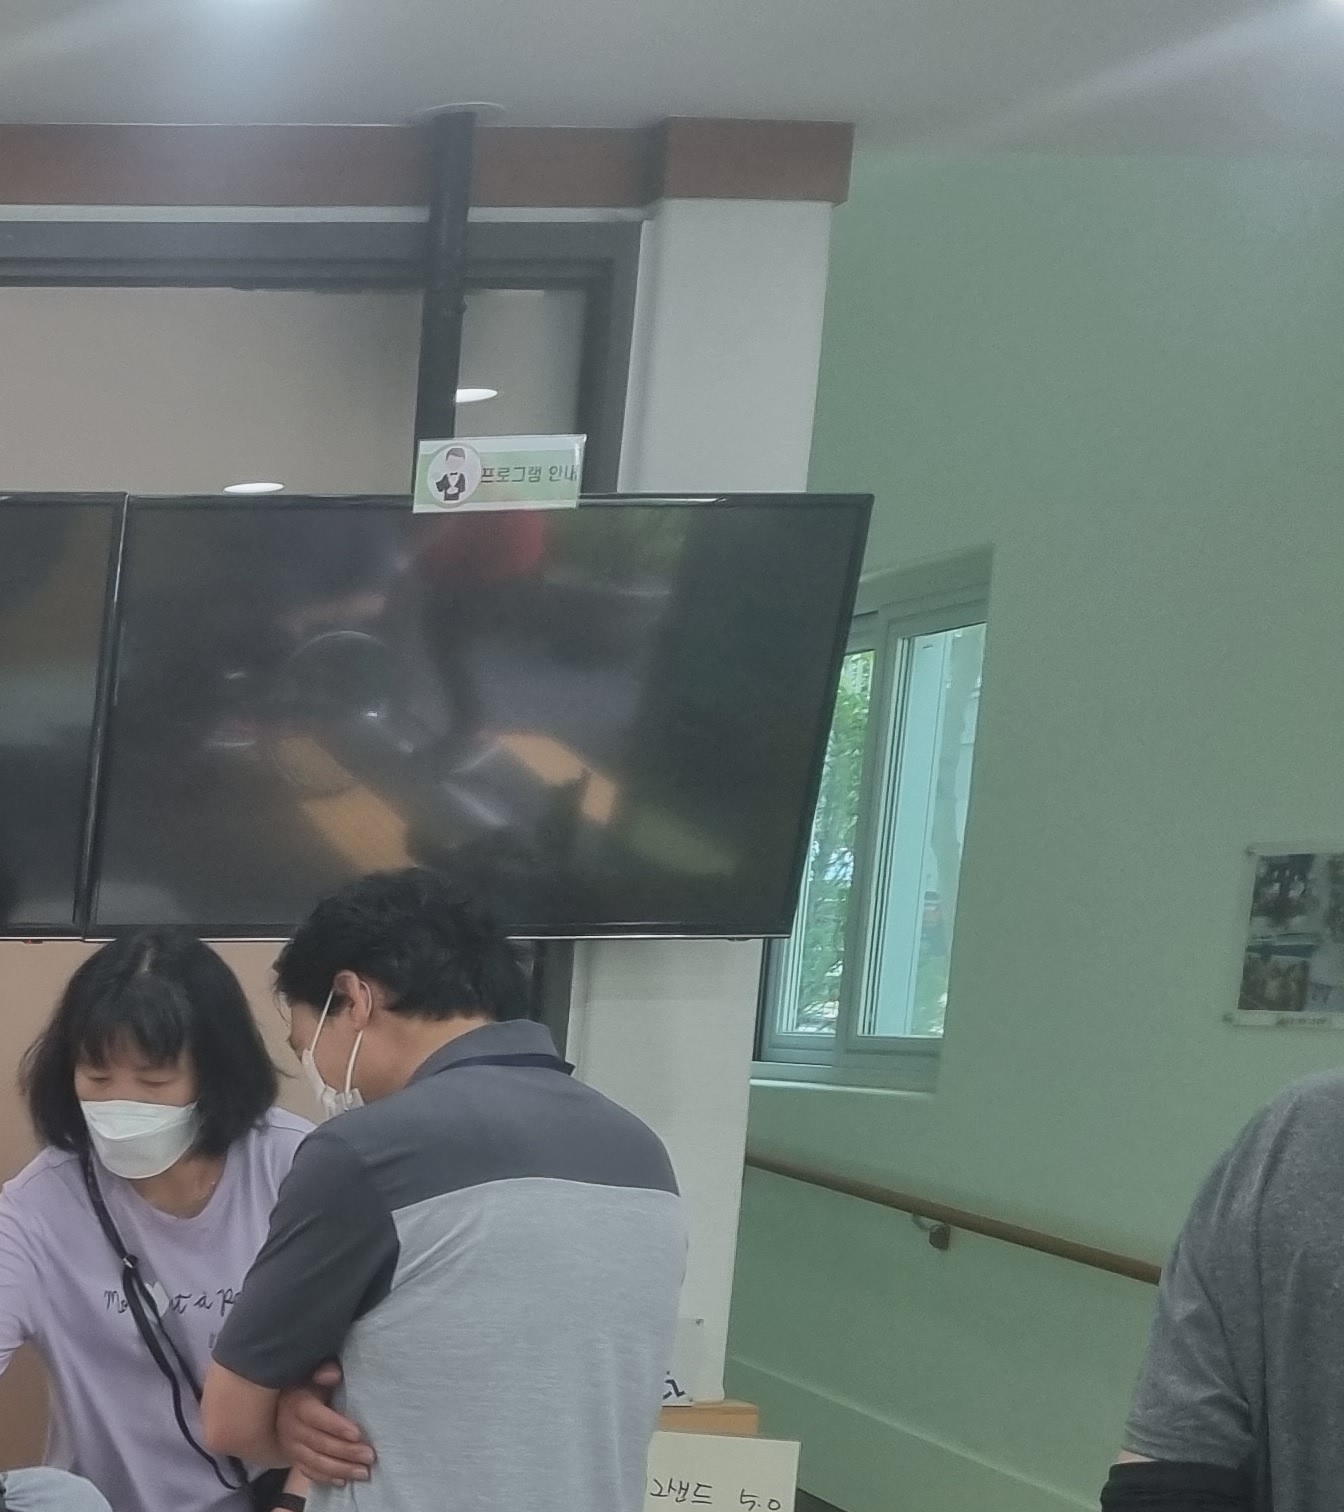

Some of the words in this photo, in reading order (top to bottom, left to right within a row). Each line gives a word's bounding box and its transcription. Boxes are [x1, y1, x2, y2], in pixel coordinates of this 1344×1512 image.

[481, 466, 542, 483] 프로그램
[549, 465, 578, 482] 안내
[740, 1488, 781, 1511] 5.0
